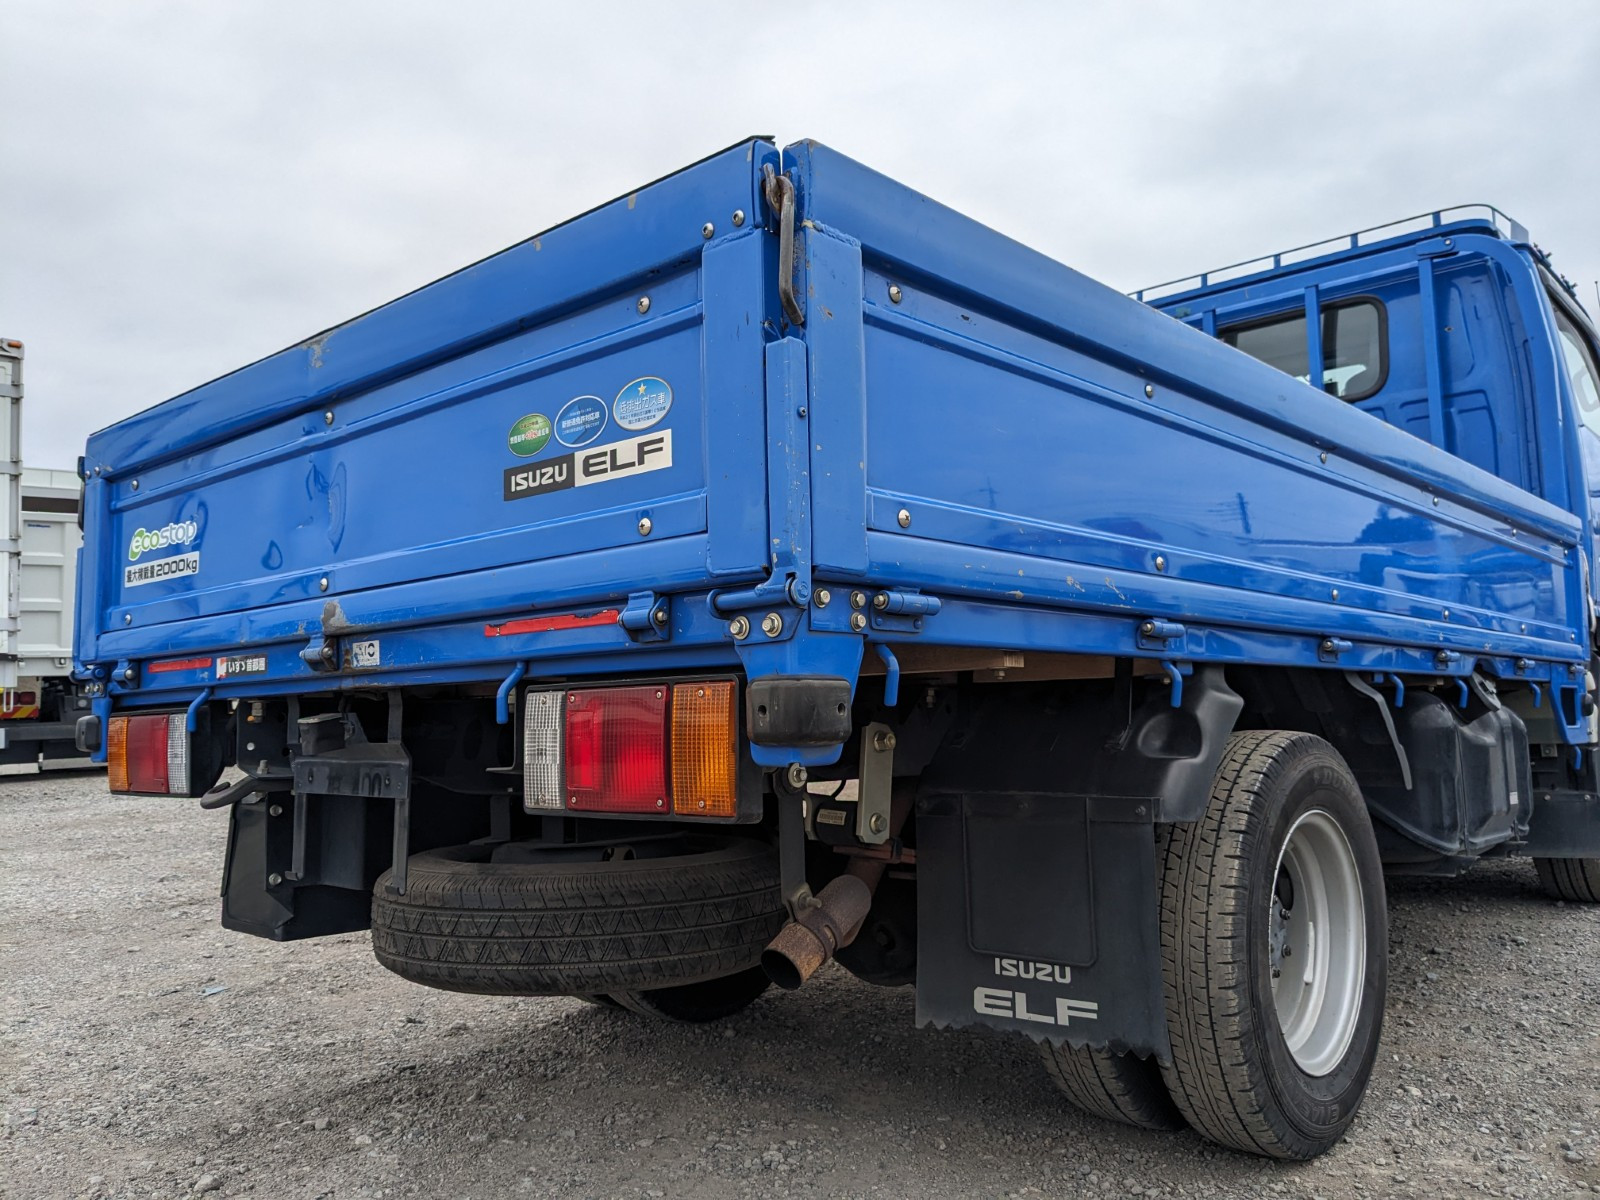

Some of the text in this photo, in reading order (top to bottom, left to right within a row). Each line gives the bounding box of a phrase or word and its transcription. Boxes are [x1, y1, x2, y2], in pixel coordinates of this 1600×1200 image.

[511, 437, 664, 492] ISUZU ELF
[131, 520, 197, 554] ecostop
[994, 957, 1071, 984] ISUZU
[974, 986, 1098, 1027] ELF
